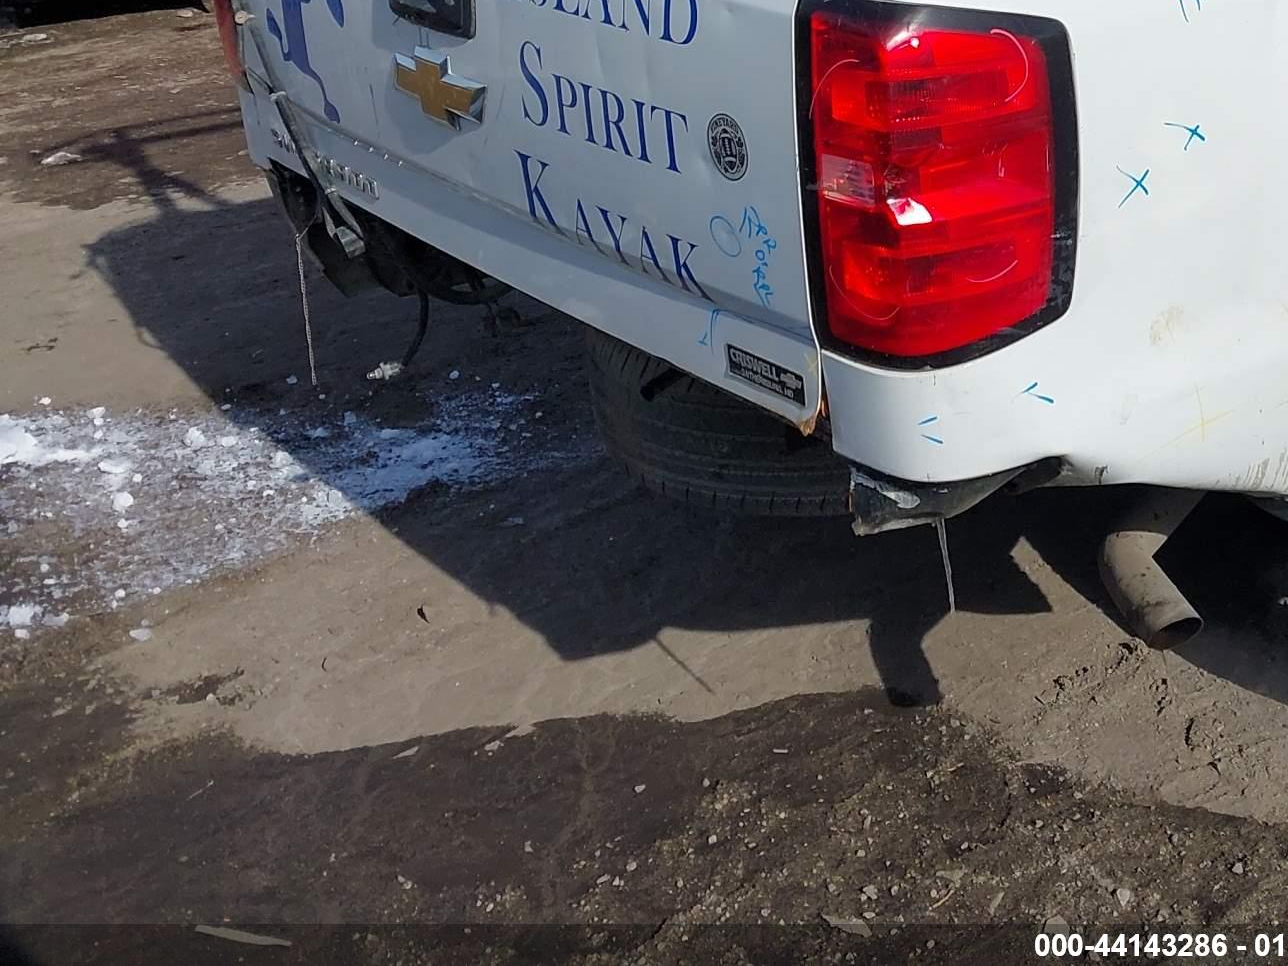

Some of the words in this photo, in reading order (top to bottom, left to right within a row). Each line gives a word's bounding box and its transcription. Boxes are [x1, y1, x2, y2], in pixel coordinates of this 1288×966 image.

[519, 40, 689, 174] SPIRIT
[512, 149, 717, 304] KAYAK
[728, 347, 780, 384] CRISWELL
